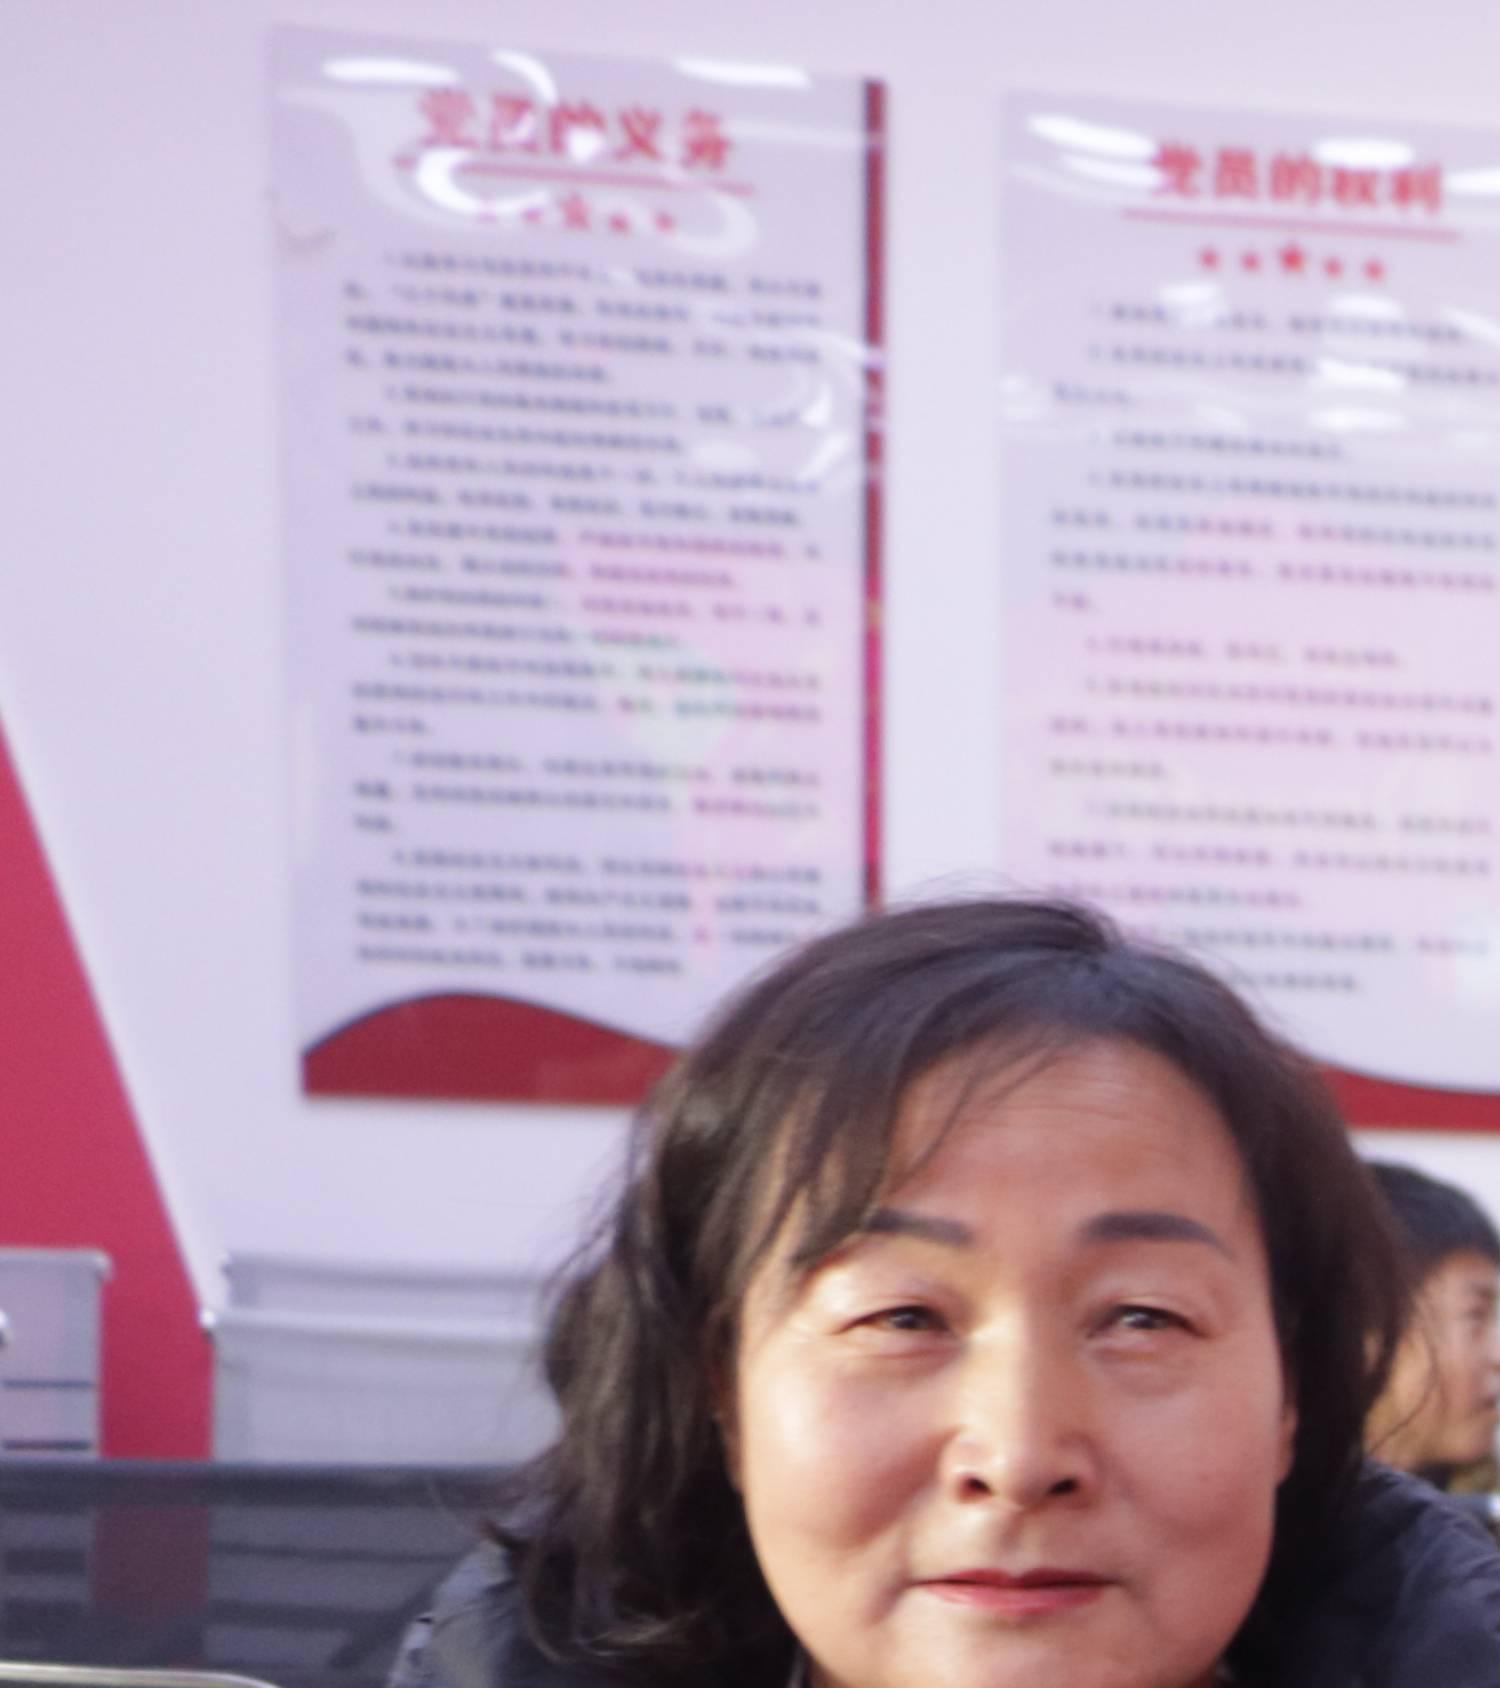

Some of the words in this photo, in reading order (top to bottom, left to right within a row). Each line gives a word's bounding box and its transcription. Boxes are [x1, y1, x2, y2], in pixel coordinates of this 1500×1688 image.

[1150, 141, 1444, 216] 党员的权利
